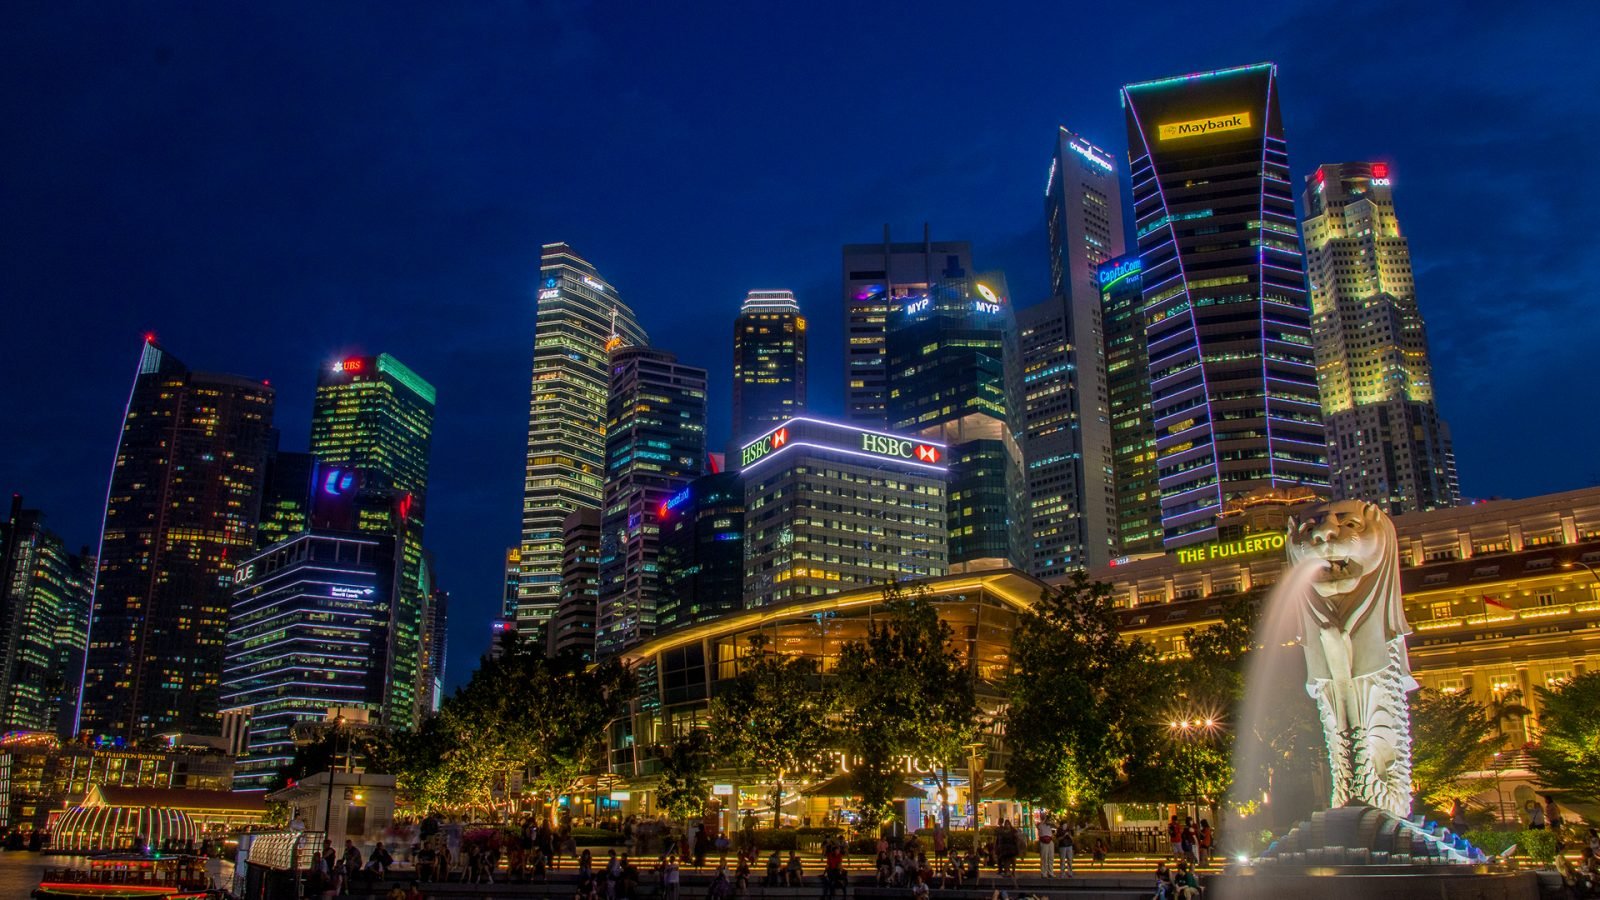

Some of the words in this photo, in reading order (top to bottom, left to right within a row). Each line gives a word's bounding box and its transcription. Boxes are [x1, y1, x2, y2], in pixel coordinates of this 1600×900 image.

[1178, 116, 1242, 134] Maybank
[1371, 178, 1390, 186] UOB
[540, 289, 559, 300] ANZ
[907, 298, 929, 316] MYP
[975, 301, 1000, 315] MYP
[343, 360, 361, 370] UBS
[741, 436, 771, 467] HSBC
[861, 432, 913, 459] HSBC
[1177, 549, 1206, 563] THE
[1210, 534, 1288, 559] FULLERTO
[94, 750, 104, 758] THE
[105, 751, 138, 760] FULLERTON
